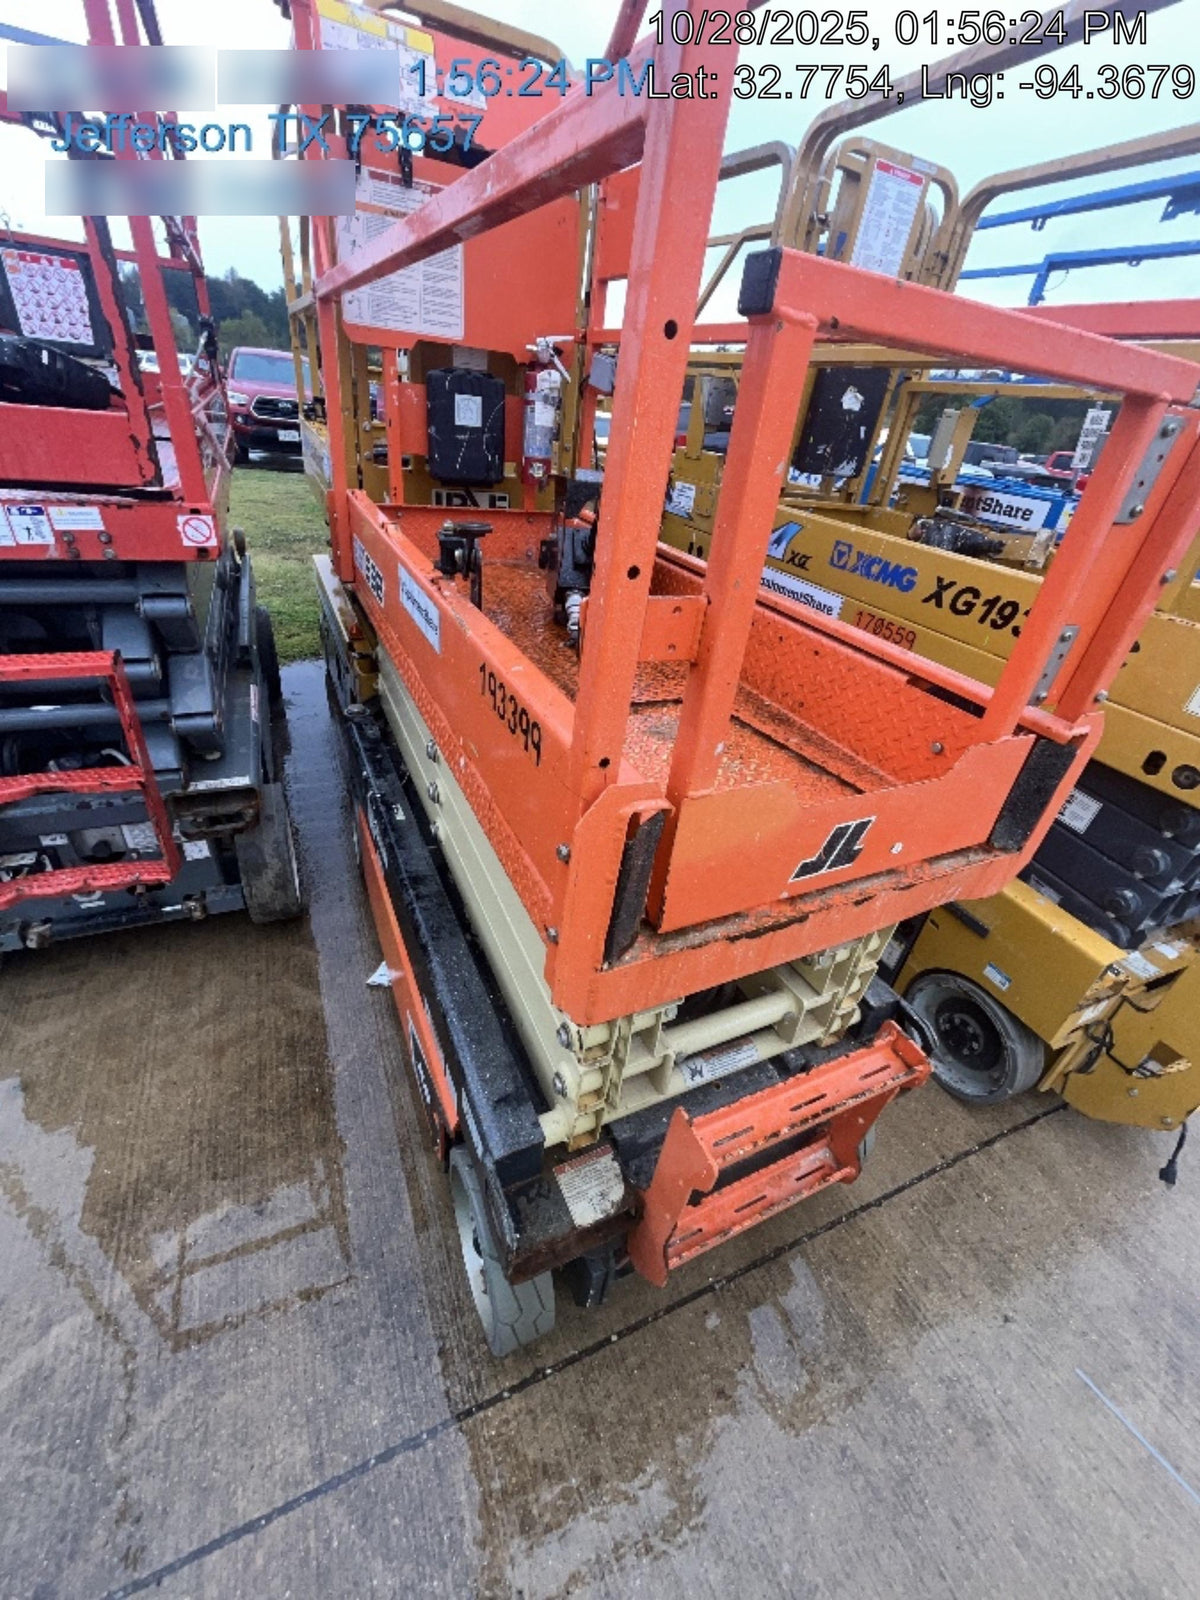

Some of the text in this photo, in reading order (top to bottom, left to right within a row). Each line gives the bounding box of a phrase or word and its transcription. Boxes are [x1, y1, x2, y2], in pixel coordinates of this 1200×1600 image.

[848, 550, 919, 593] XCMG
[855, 610, 918, 650] 170559
[479, 661, 542, 768] 193399
